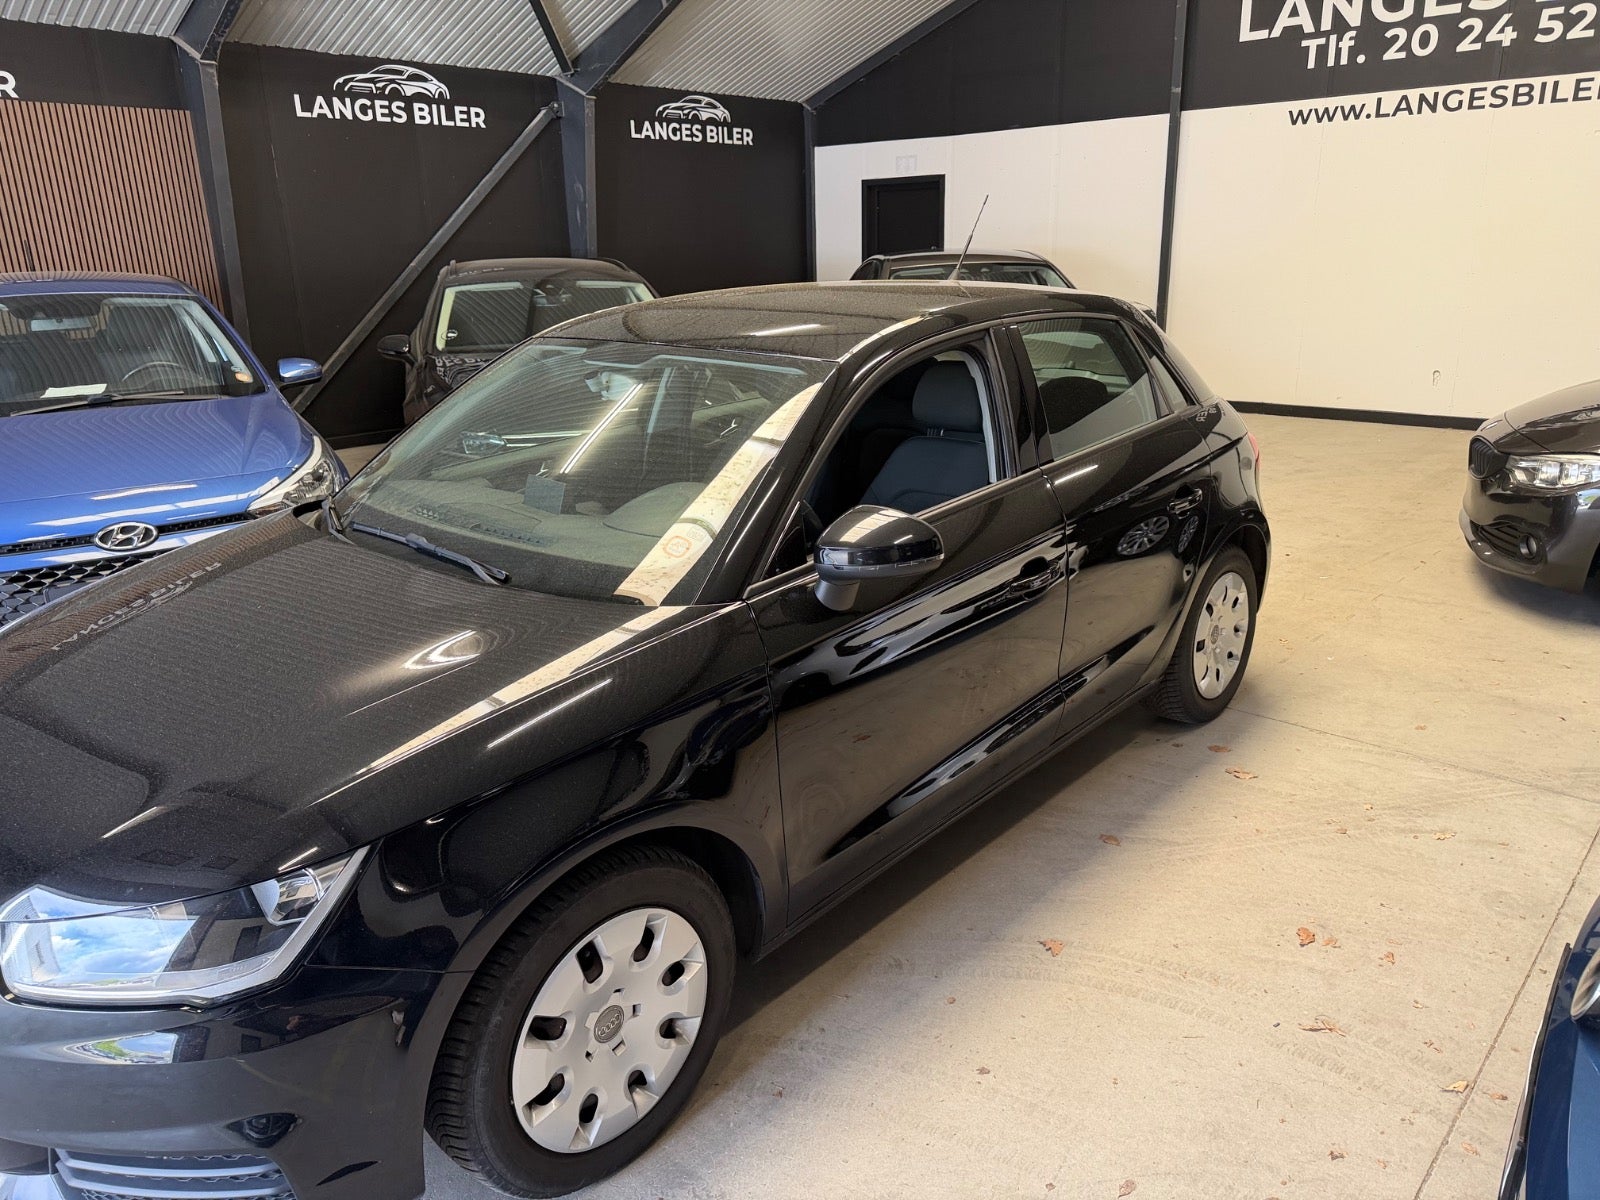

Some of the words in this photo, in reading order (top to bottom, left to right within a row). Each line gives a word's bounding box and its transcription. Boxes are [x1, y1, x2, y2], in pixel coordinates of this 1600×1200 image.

[1238, 0, 1508, 43] LANG
[1301, 30, 1366, 69] Tlf.
[1382, 23, 1439, 61] 20
[1456, 12, 1518, 53] 24
[1533, 2, 1598, 43] 52
[293, 93, 408, 124] LANGES
[412, 102, 487, 129] BILER
[1288, 75, 1600, 126] www.LANGESBILE
[629, 119, 703, 143] LANGES
[706, 125, 754, 146] BILER
